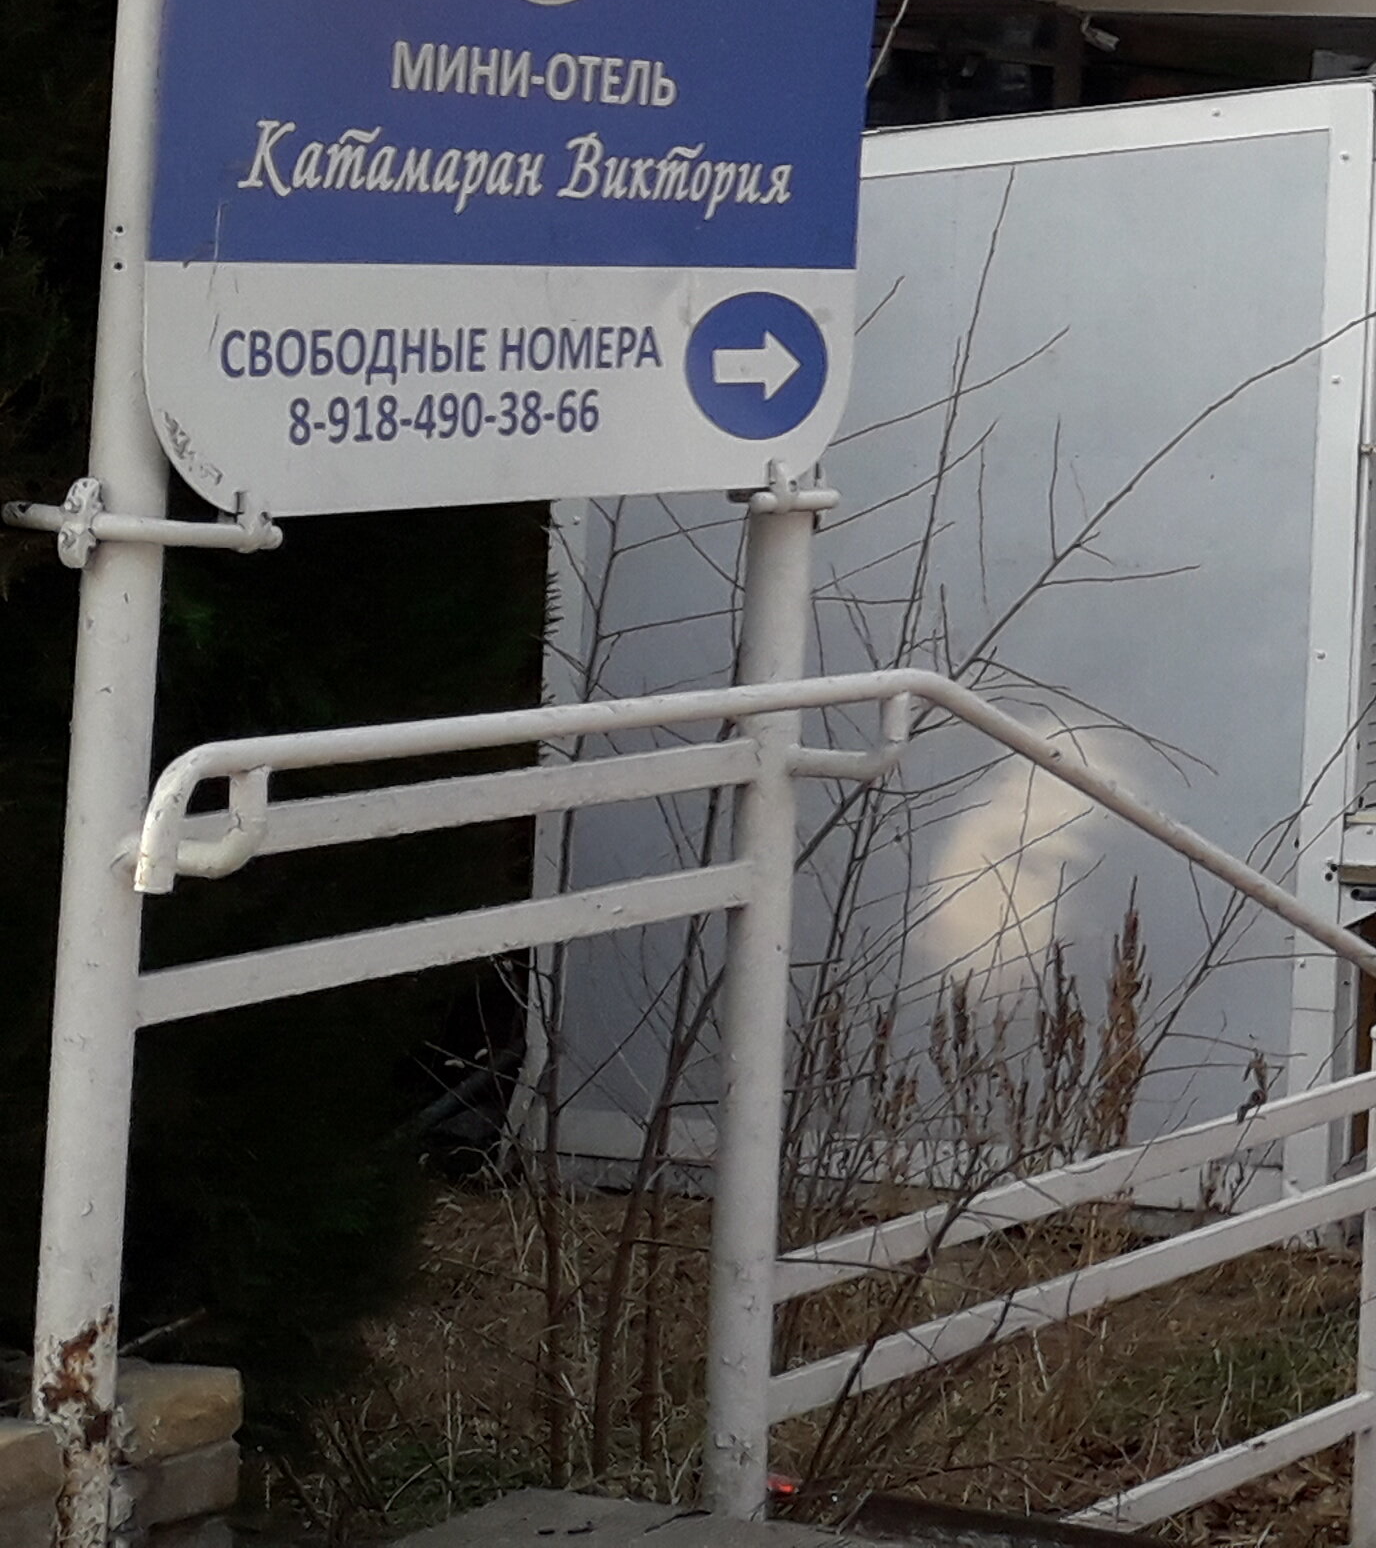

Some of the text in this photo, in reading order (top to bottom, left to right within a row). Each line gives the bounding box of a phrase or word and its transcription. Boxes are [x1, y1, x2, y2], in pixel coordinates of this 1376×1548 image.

[391, 41, 677, 107] МИНИ-ОТЕЛЬ
[237, 119, 794, 219] Катамаран Виктория
[220, 325, 663, 386] СВОБОДНЫЕ НОМЕРА
[288, 388, 600, 446] 8-918-490-38-66
